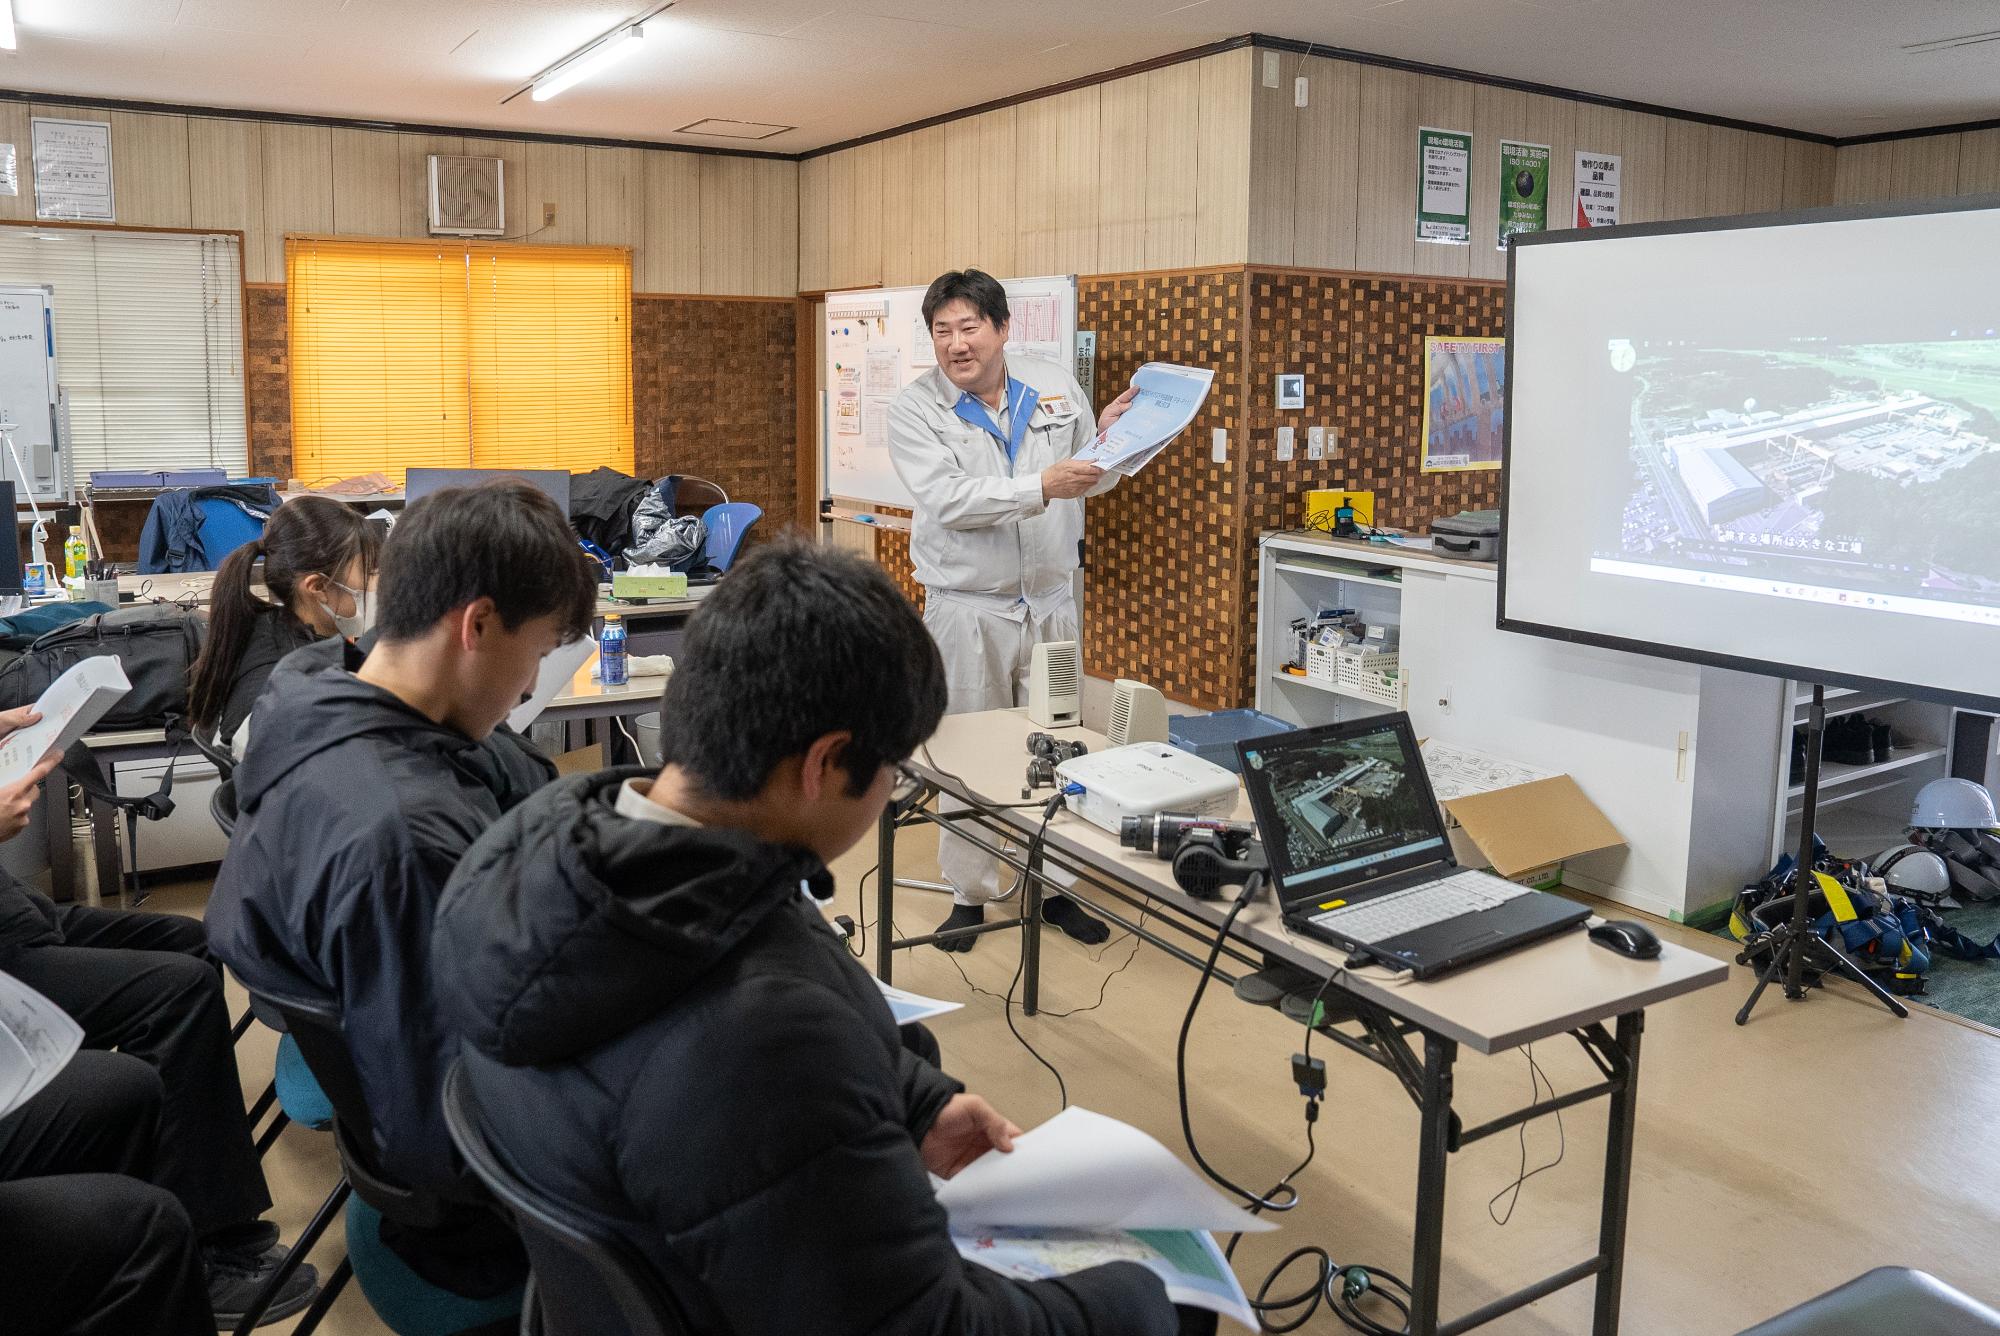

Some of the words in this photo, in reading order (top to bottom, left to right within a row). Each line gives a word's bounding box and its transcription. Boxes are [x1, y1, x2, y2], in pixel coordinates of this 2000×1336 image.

[1503, 145, 1529, 158] 環境活動
[1530, 150, 1548, 160] 実施中
[1509, 158, 1520, 166] ISO
[1522, 160, 1541, 168] 14001
[1581, 159, 1614, 171] 物作りの原点
[1592, 171, 1604, 181] 品質
[1430, 342, 1470, 353] SAFETY
[1472, 343, 1500, 353] FIRST
